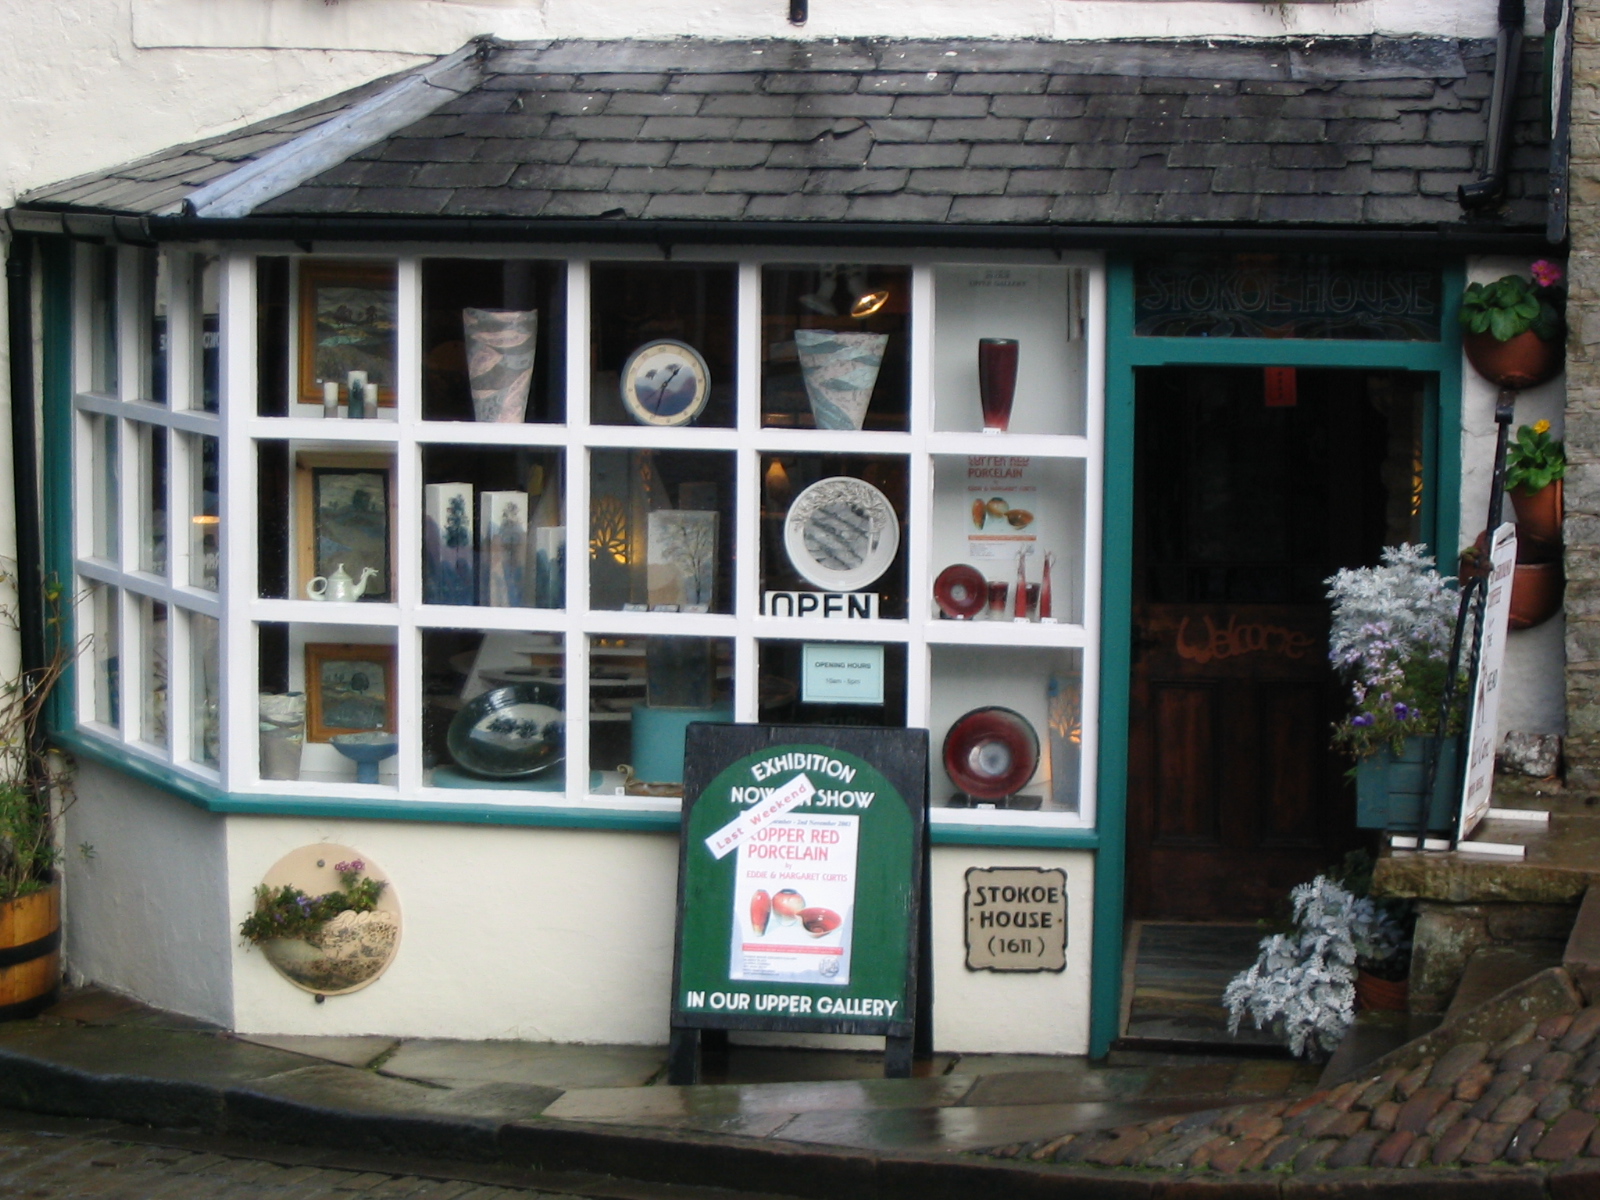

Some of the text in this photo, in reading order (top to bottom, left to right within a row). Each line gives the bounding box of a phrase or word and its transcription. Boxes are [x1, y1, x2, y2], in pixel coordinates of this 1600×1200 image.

[1142, 269, 1435, 316] STOKOE HOUSE
[968, 467, 1023, 479] PORCELAIN
[815, 661, 872, 670] OPENING HOURS
[751, 753, 857, 784] EXHIBITION
[815, 789, 876, 809] SHOW
[716, 783, 807, 850] Last Weekend
[811, 829, 840, 845] RED
[748, 844, 829, 861] PORCELAIN
[746, 870, 848, 882] EDDIE & MARGARET CURTIS
[973, 886, 1059, 906] STOKOE
[980, 910, 1053, 929] HOUSE
[687, 991, 899, 1016] IN OUR UPPER GALLERY
